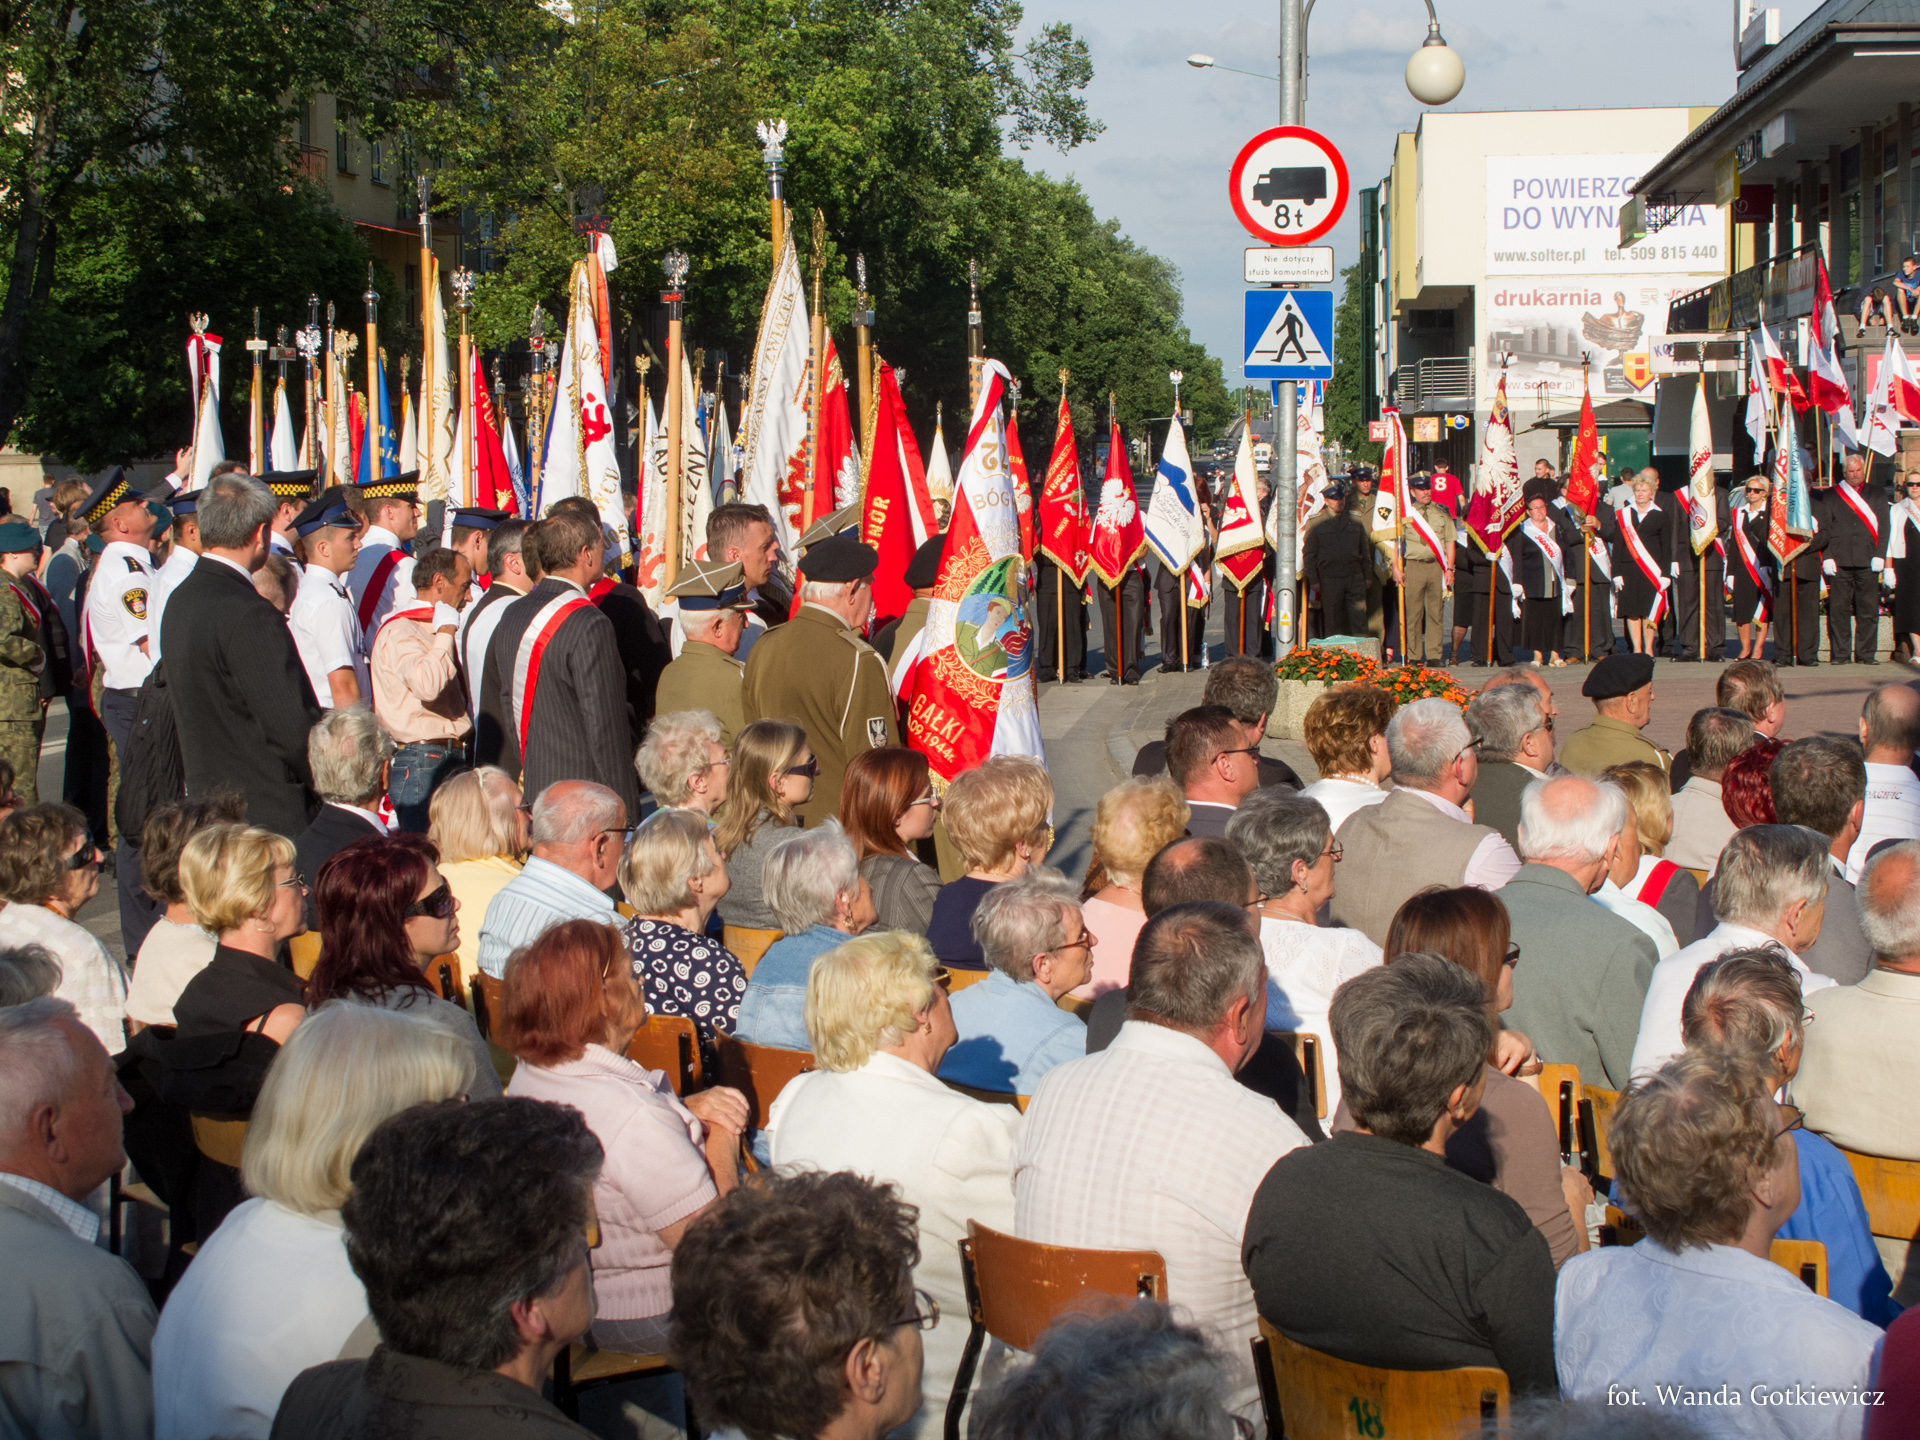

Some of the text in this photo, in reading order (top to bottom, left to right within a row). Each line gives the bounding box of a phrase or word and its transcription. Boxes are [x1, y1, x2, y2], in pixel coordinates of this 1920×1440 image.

[1513, 176, 1643, 199] POWIERZC
[1274, 203, 1304, 229] 8 t
[1503, 203, 1707, 230] DO WYNCIA
[1263, 255, 1315, 264] Nie dotyczy
[1494, 245, 1718, 264] www.solter.pl tel. 509 815 440
[1273, 268, 1329, 278] komunalnych
[1493, 289, 1602, 307] drukarnia
[1434, 476, 1446, 491] 8
[972, 486, 1010, 511] BÓG
[866, 496, 891, 551] ONOR
[911, 693, 966, 745] GAŁKI
[1348, 1396, 1385, 1440] 18
